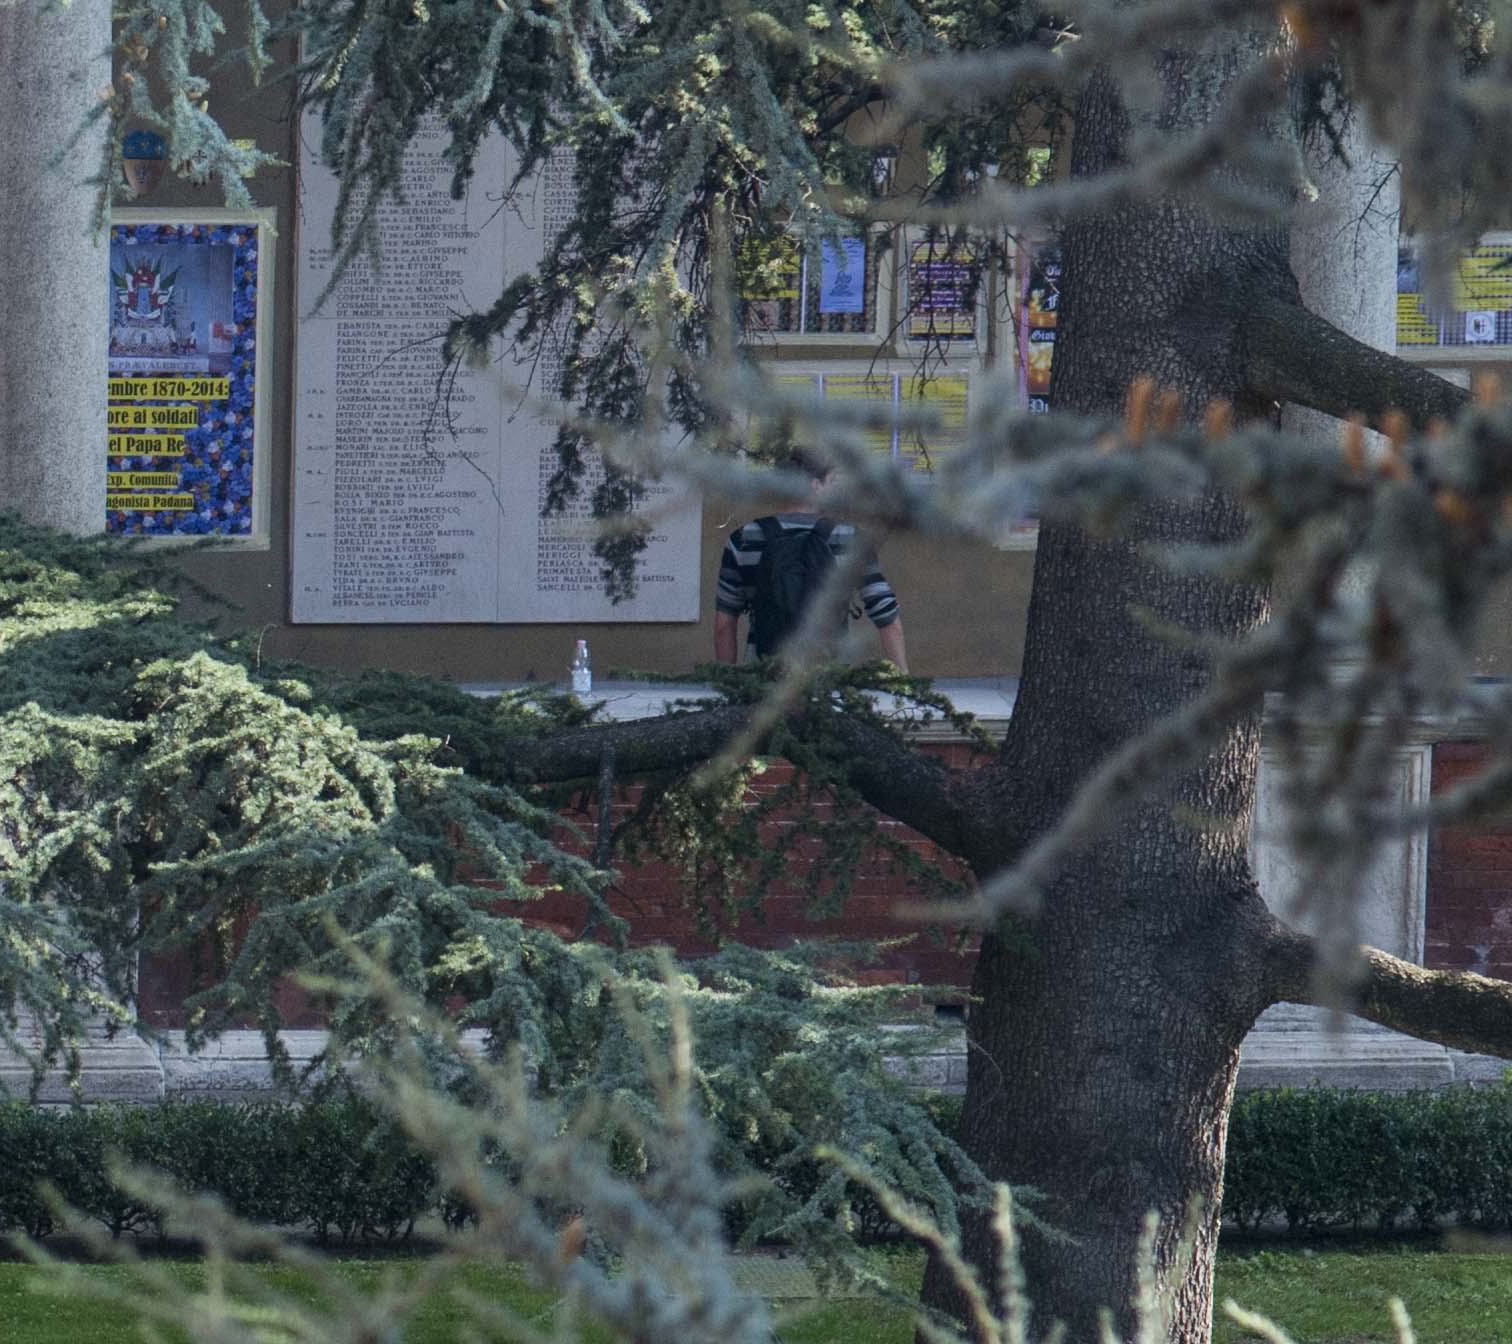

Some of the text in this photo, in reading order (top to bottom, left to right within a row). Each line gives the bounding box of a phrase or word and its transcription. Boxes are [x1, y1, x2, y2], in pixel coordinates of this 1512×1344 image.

[152, 381, 229, 397] 1870-2014:
[107, 408, 198, 425] ore ai soldati
[109, 436, 184, 454] el Papa Re
[106, 495, 193, 510] agonista Padana
